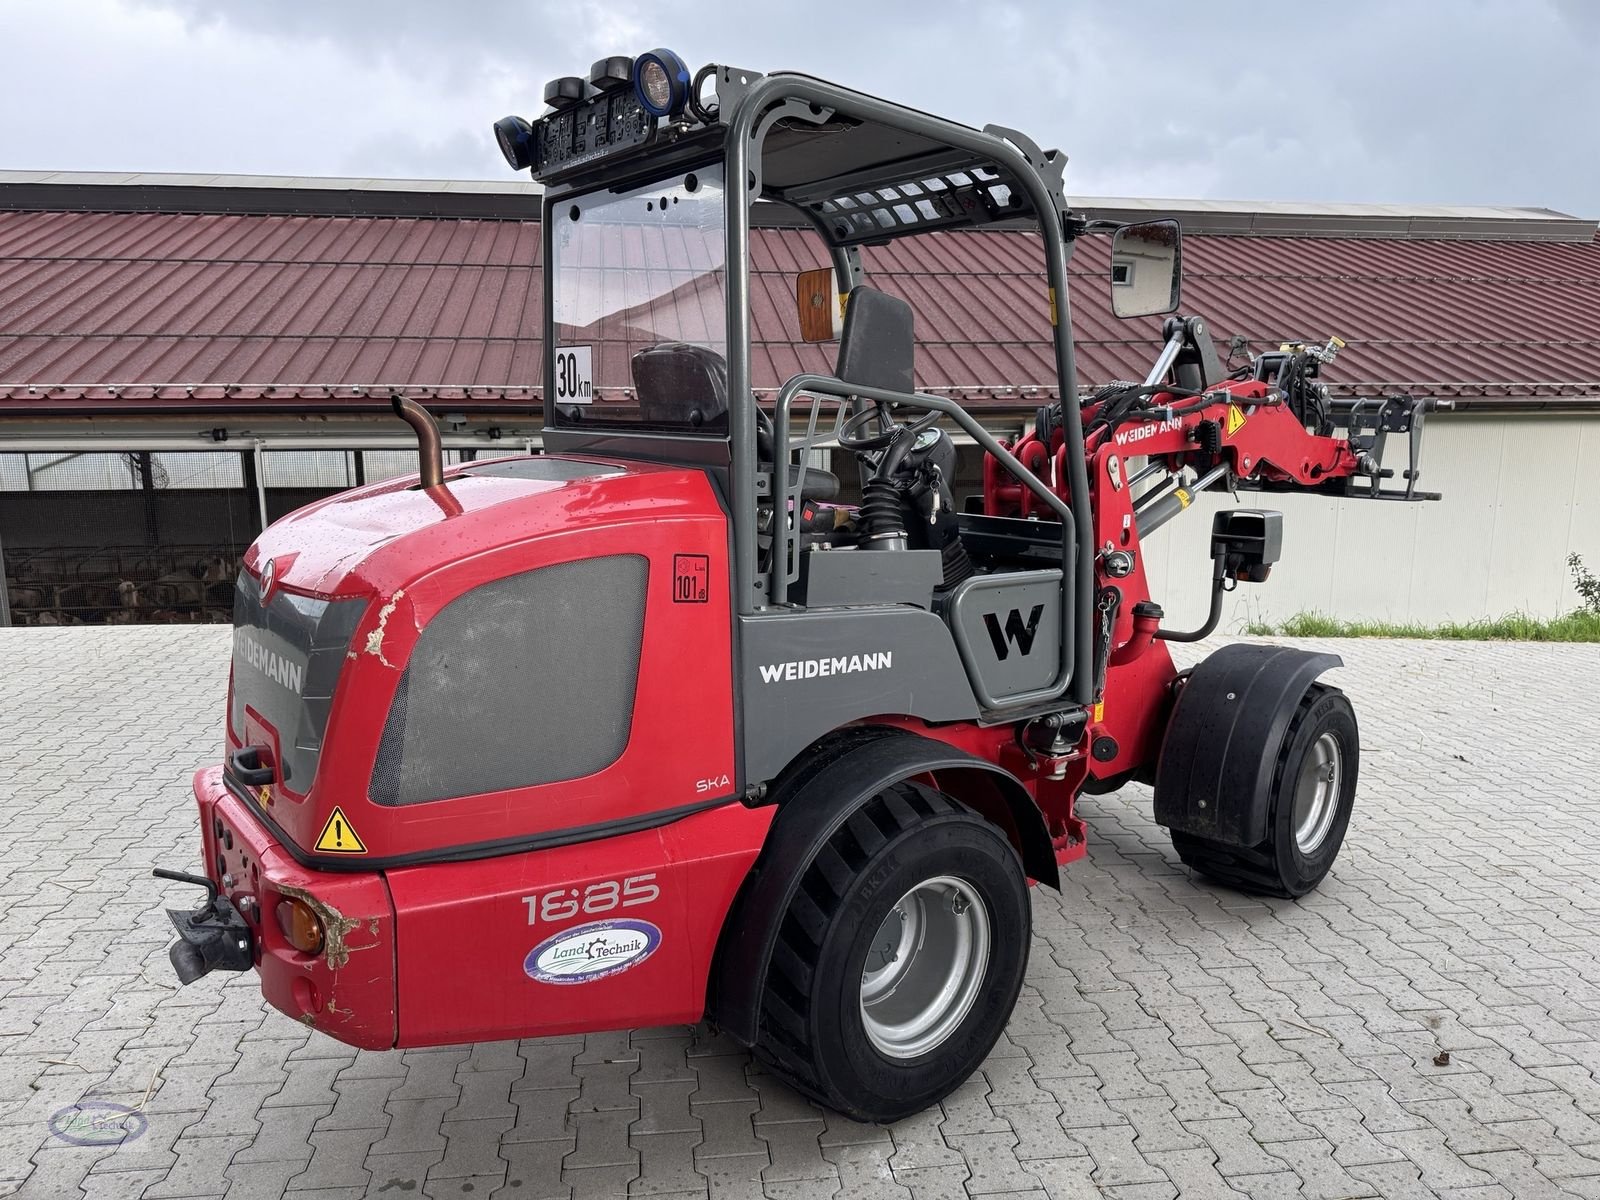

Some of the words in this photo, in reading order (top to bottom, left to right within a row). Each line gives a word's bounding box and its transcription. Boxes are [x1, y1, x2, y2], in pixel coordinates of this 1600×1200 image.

[557, 353, 577, 398] 30
[577, 373, 591, 397] km
[677, 575, 697, 599] 101
[982, 604, 1045, 661] W
[759, 651, 892, 684] WEIDEMANN
[696, 774, 730, 793] SKA
[521, 873, 660, 926] 1685
[553, 943, 586, 960] Land
[596, 939, 642, 958] Technik
